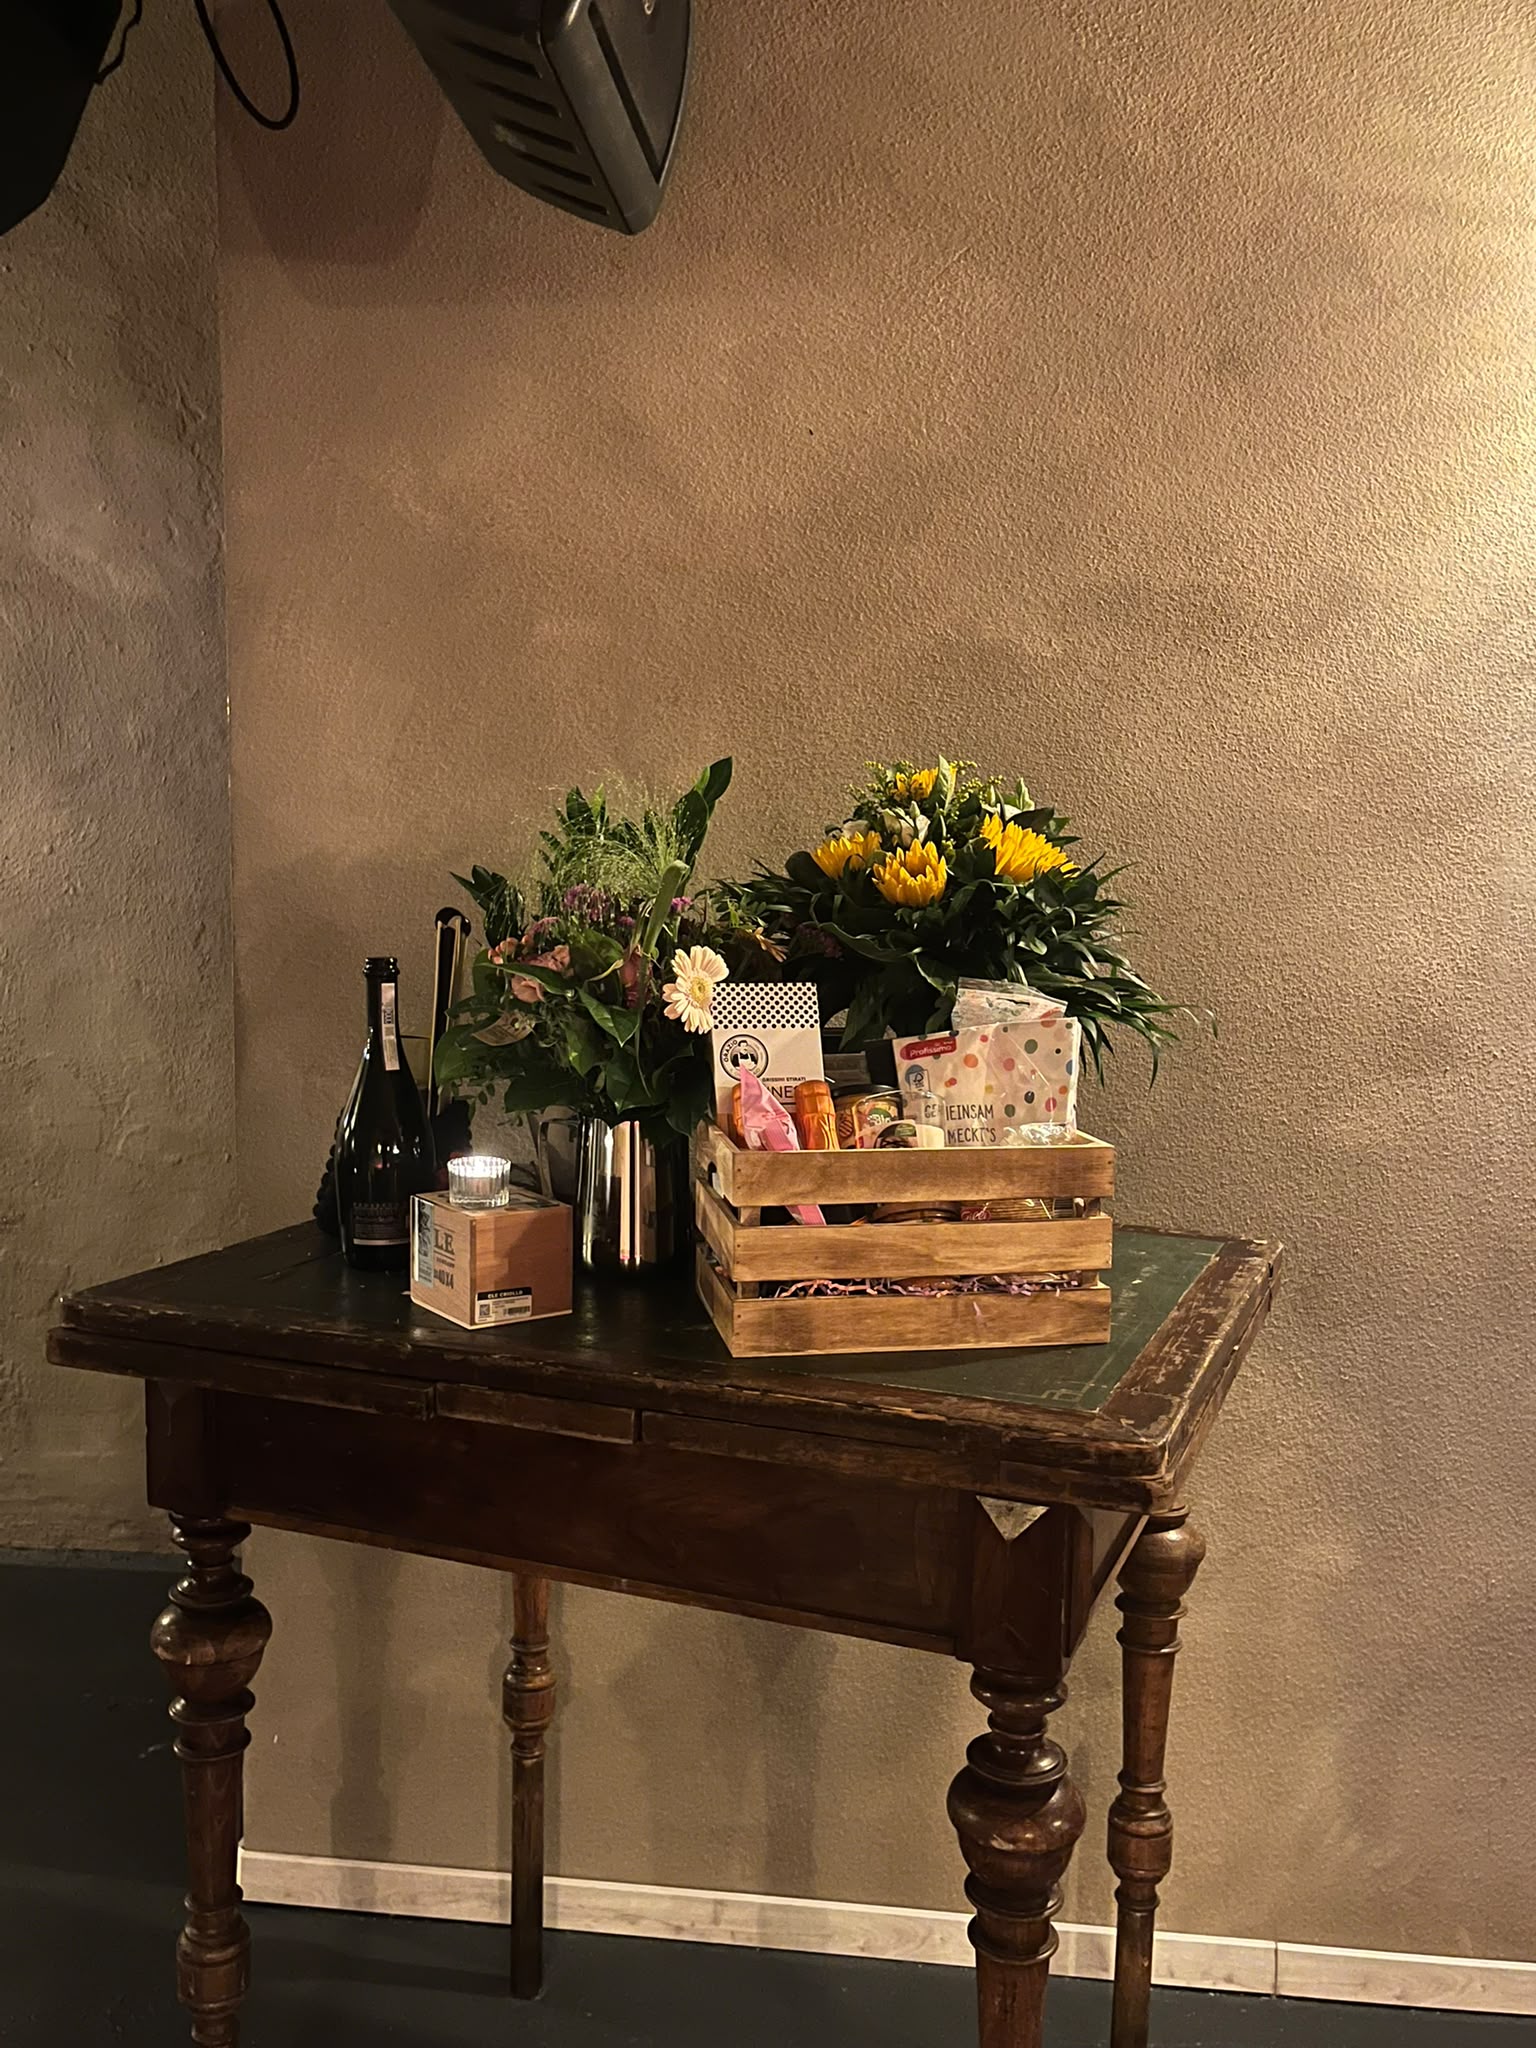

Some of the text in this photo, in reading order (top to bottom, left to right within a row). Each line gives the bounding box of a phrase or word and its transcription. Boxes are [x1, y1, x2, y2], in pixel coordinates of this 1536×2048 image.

[723, 1039, 738, 1063] ORAZIO
[909, 1044, 953, 1058] Profissimo
[924, 1104, 995, 1121] GEEINSAM
[947, 1126, 997, 1144] MECKT'S
[433, 1228, 455, 1256] LE
